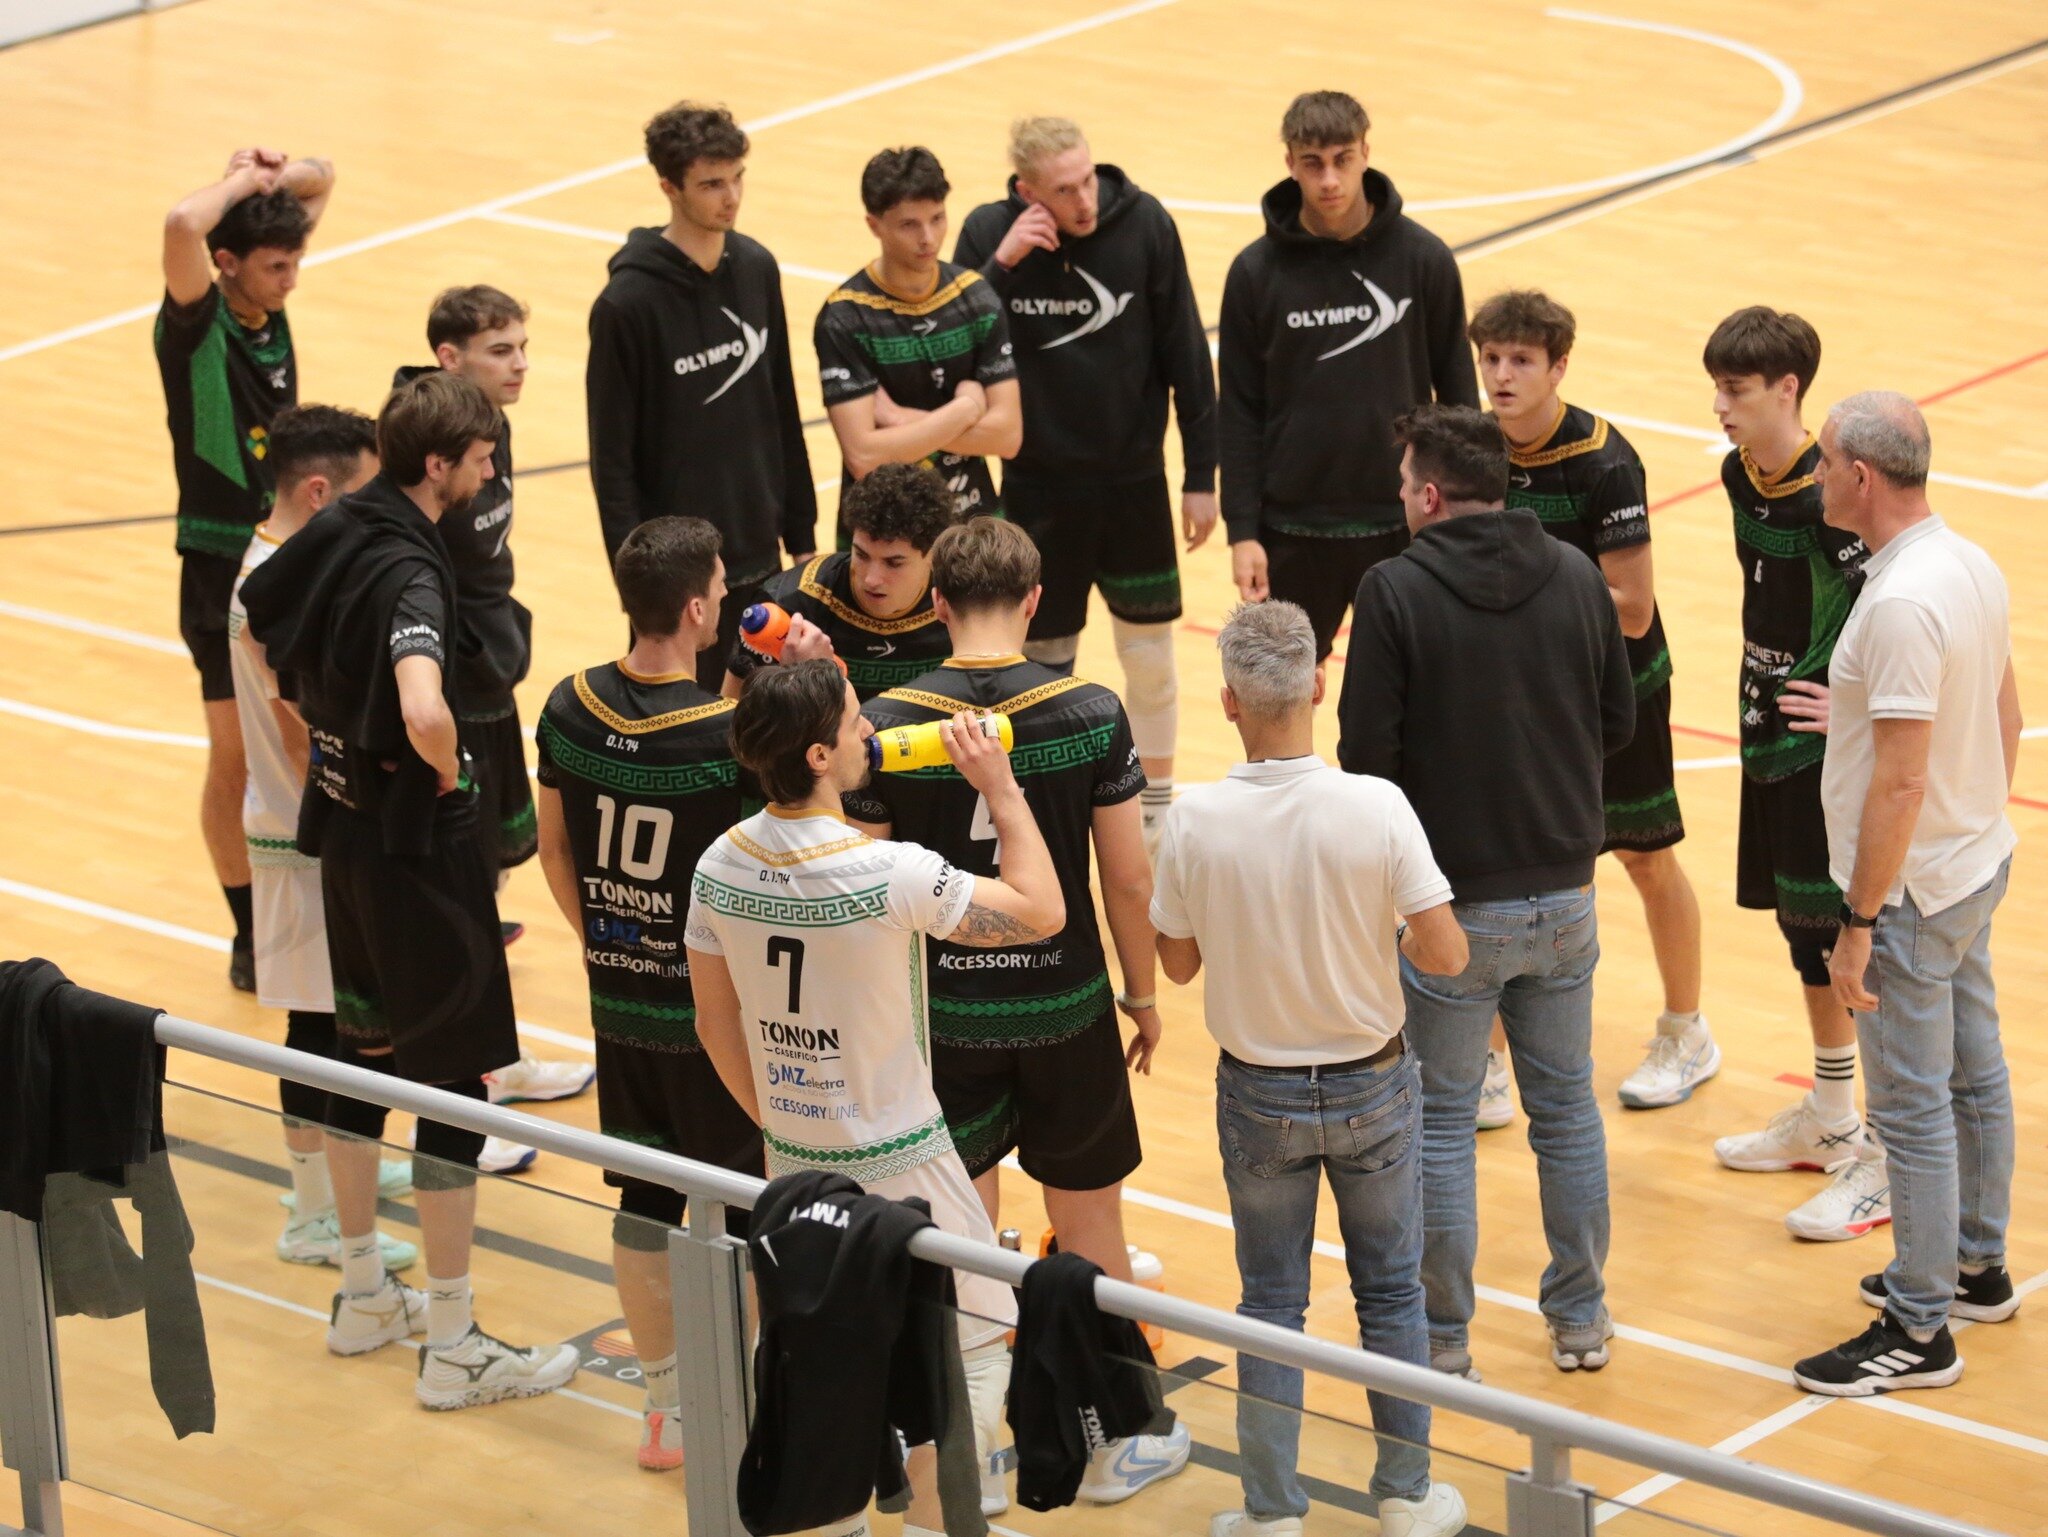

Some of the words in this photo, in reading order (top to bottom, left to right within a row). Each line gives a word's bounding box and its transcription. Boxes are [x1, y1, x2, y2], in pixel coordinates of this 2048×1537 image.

[1009, 298, 1094, 316] OLYMPO
[1286, 304, 1373, 329] OLYMPO
[674, 339, 744, 375] OLYMPO
[389, 623, 440, 647] OLYMPO
[605, 733, 640, 753] 0.1.74
[596, 793, 674, 881] 10
[759, 869, 791, 885] 0.1.74
[583, 876, 673, 915] TONON
[766, 935, 805, 1015] 7
[758, 1018, 840, 1051] TONON
[774, 1046, 818, 1063] CASEIFICIO
